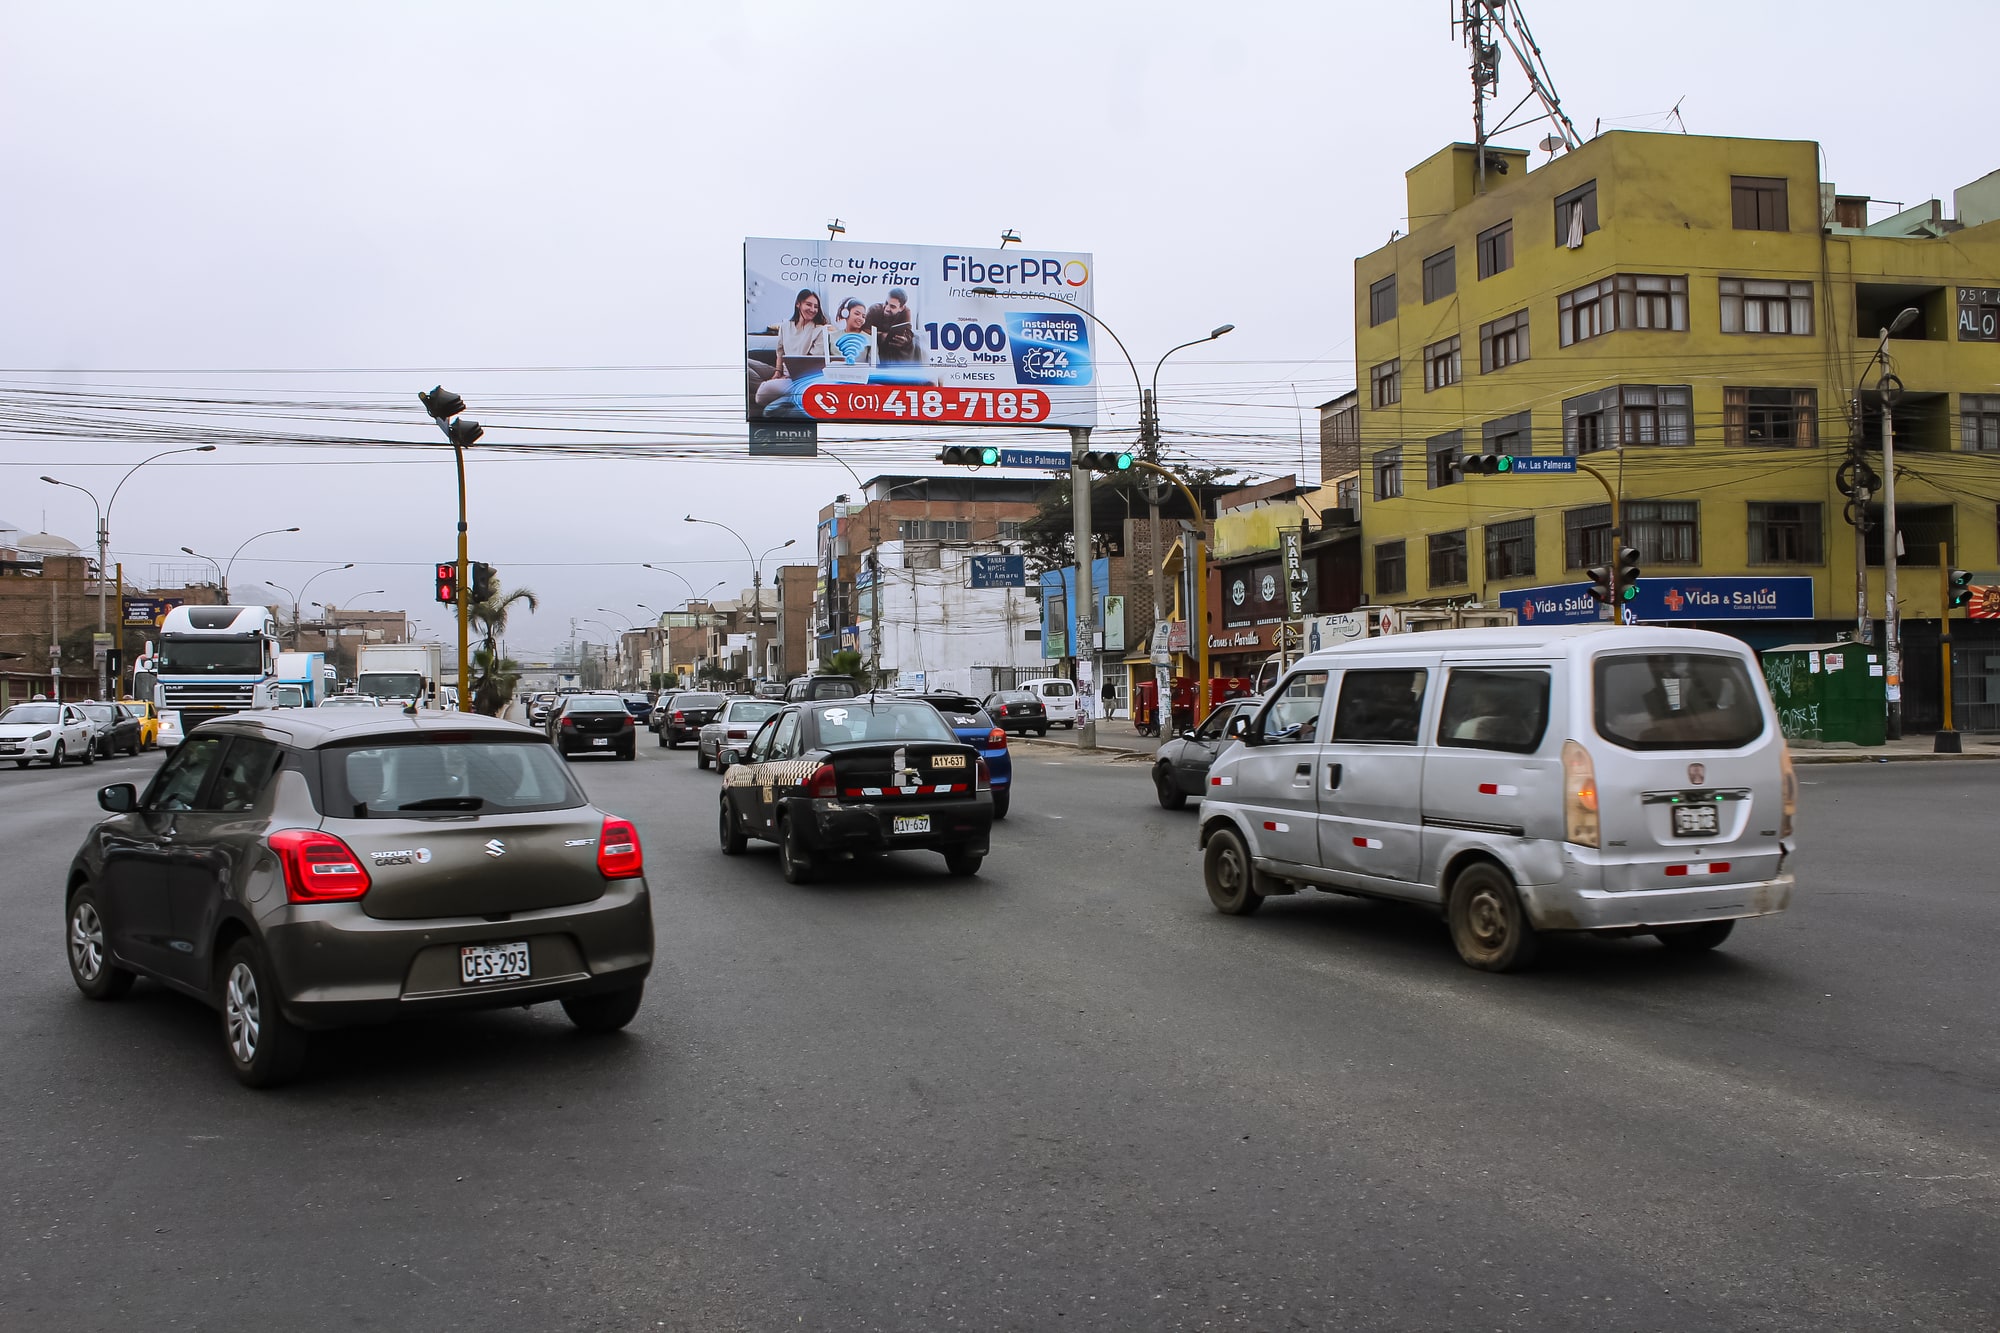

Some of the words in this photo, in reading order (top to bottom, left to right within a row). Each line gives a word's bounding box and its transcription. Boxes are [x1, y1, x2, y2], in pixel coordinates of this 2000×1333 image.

[780, 254, 843, 268] Conecta
[848, 258, 864, 269] tu
[869, 258, 917, 273] hogar
[942, 254, 1089, 287] FiberPRO
[781, 271, 809, 281] con
[813, 270, 827, 282] la
[831, 272, 878, 286] mejor
[882, 272, 920, 286] fibra
[1002, 288, 1017, 299] de
[1020, 290, 1046, 300] otro
[1049, 290, 1077, 301] nivel
[1022, 320, 1077, 329] Instalación
[924, 322, 1006, 352] 1000
[1021, 329, 1079, 341] GRATIS
[973, 353, 1007, 364] Mbps
[1042, 351, 1069, 368] 24
[950, 372, 961, 380] x6
[1040, 369, 1078, 378] HORAS
[848, 391, 879, 411] (01)
[882, 389, 1040, 419] 418-7185
[1006, 454, 1018, 463] Av.
[1020, 455, 1033, 464] Las
[1035, 455, 1066, 465] Palmeras
[1518, 461, 1527, 469] Av.
[1530, 461, 1541, 469] Las
[1543, 461, 1572, 469] Palmeras
[439, 567, 452, 579] 61
[1685, 591, 1719, 605] Vida
[1723, 595, 1730, 604] &
[1535, 600, 1556, 613] Vida
[1558, 603, 1563, 611] &
[1326, 615, 1349, 626] ZETA
[1208, 634, 1228, 648] Carnes
[1234, 631, 1259, 646] Parrillas
[934, 756, 963, 767] A1Y-637
[894, 818, 929, 832] A1Y-637
[370, 850, 413, 859] SUZUKI
[375, 857, 412, 866] GACSA
[464, 950, 527, 977] CES-293
